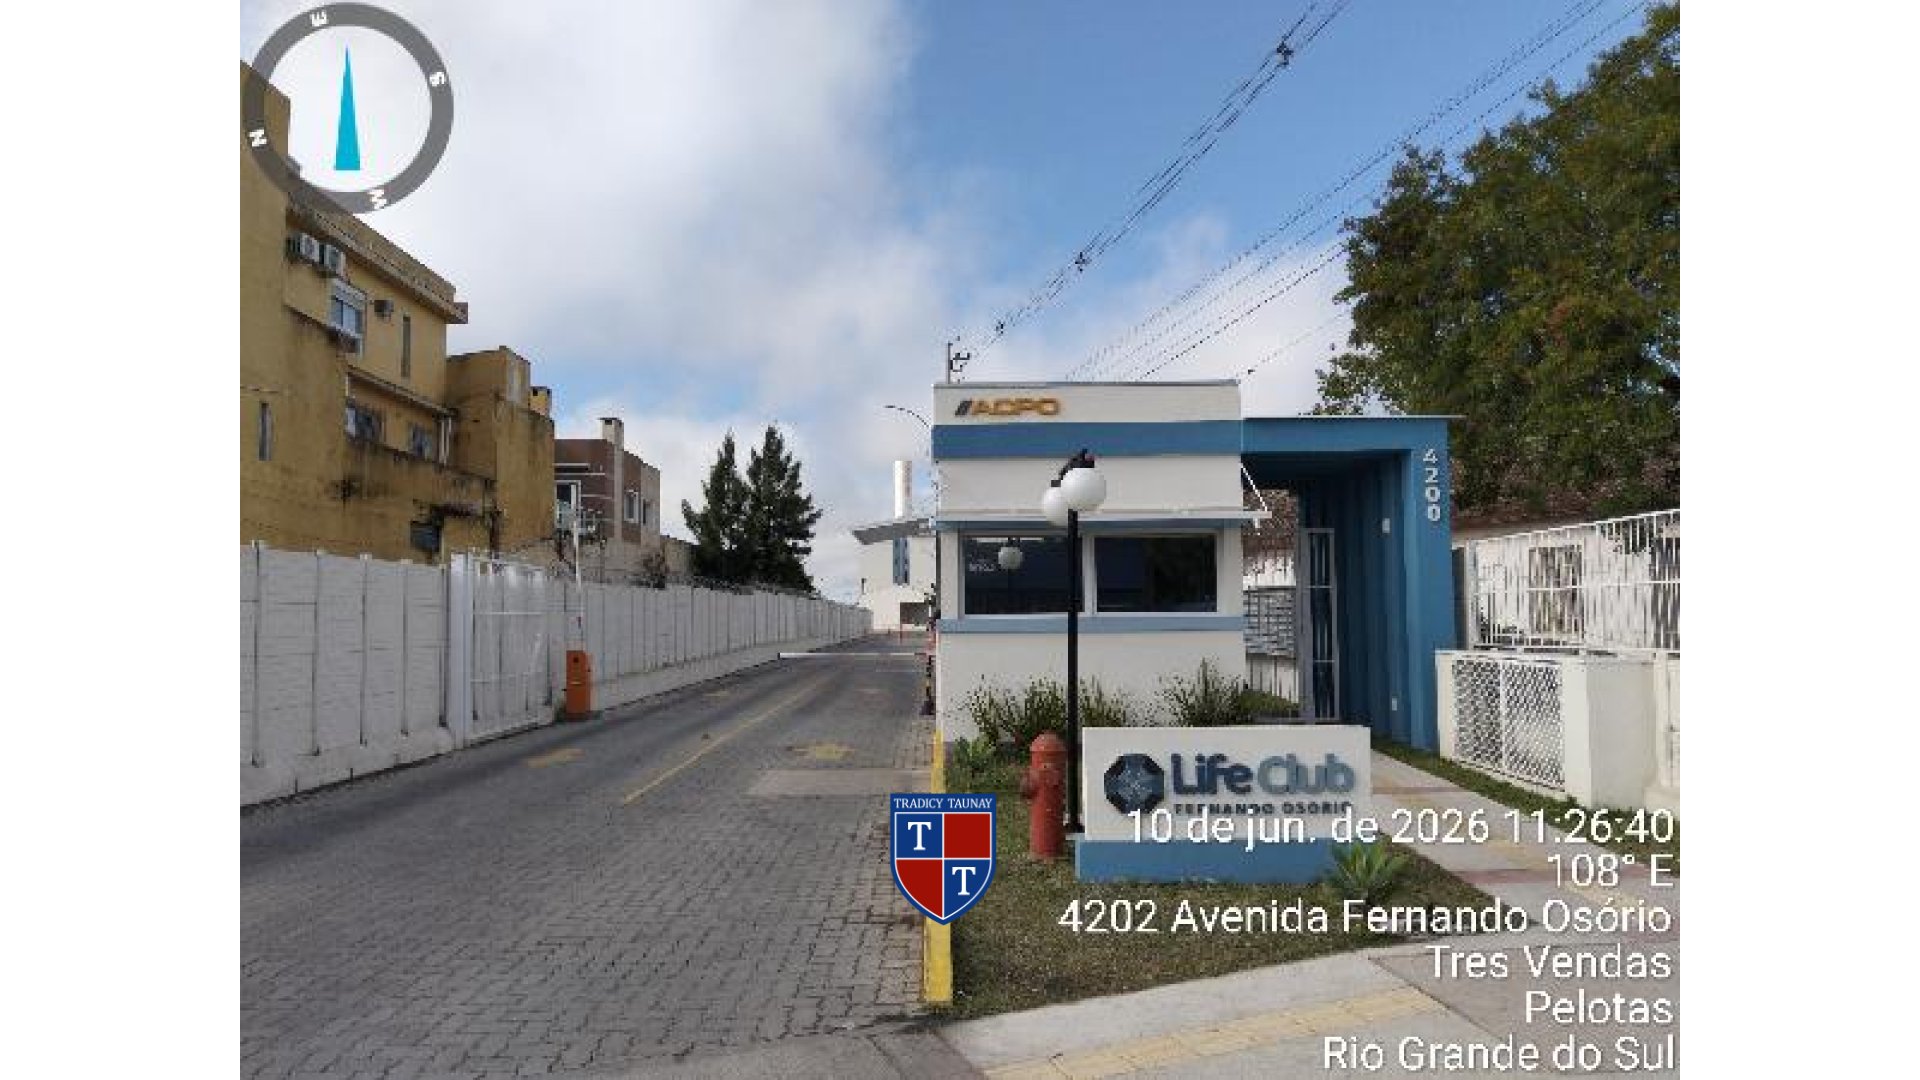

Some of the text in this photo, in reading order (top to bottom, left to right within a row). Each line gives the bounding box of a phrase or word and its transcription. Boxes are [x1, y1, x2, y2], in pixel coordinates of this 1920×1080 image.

[1423, 448, 1441, 522] 4200
[1171, 753, 1355, 795] Life Club
